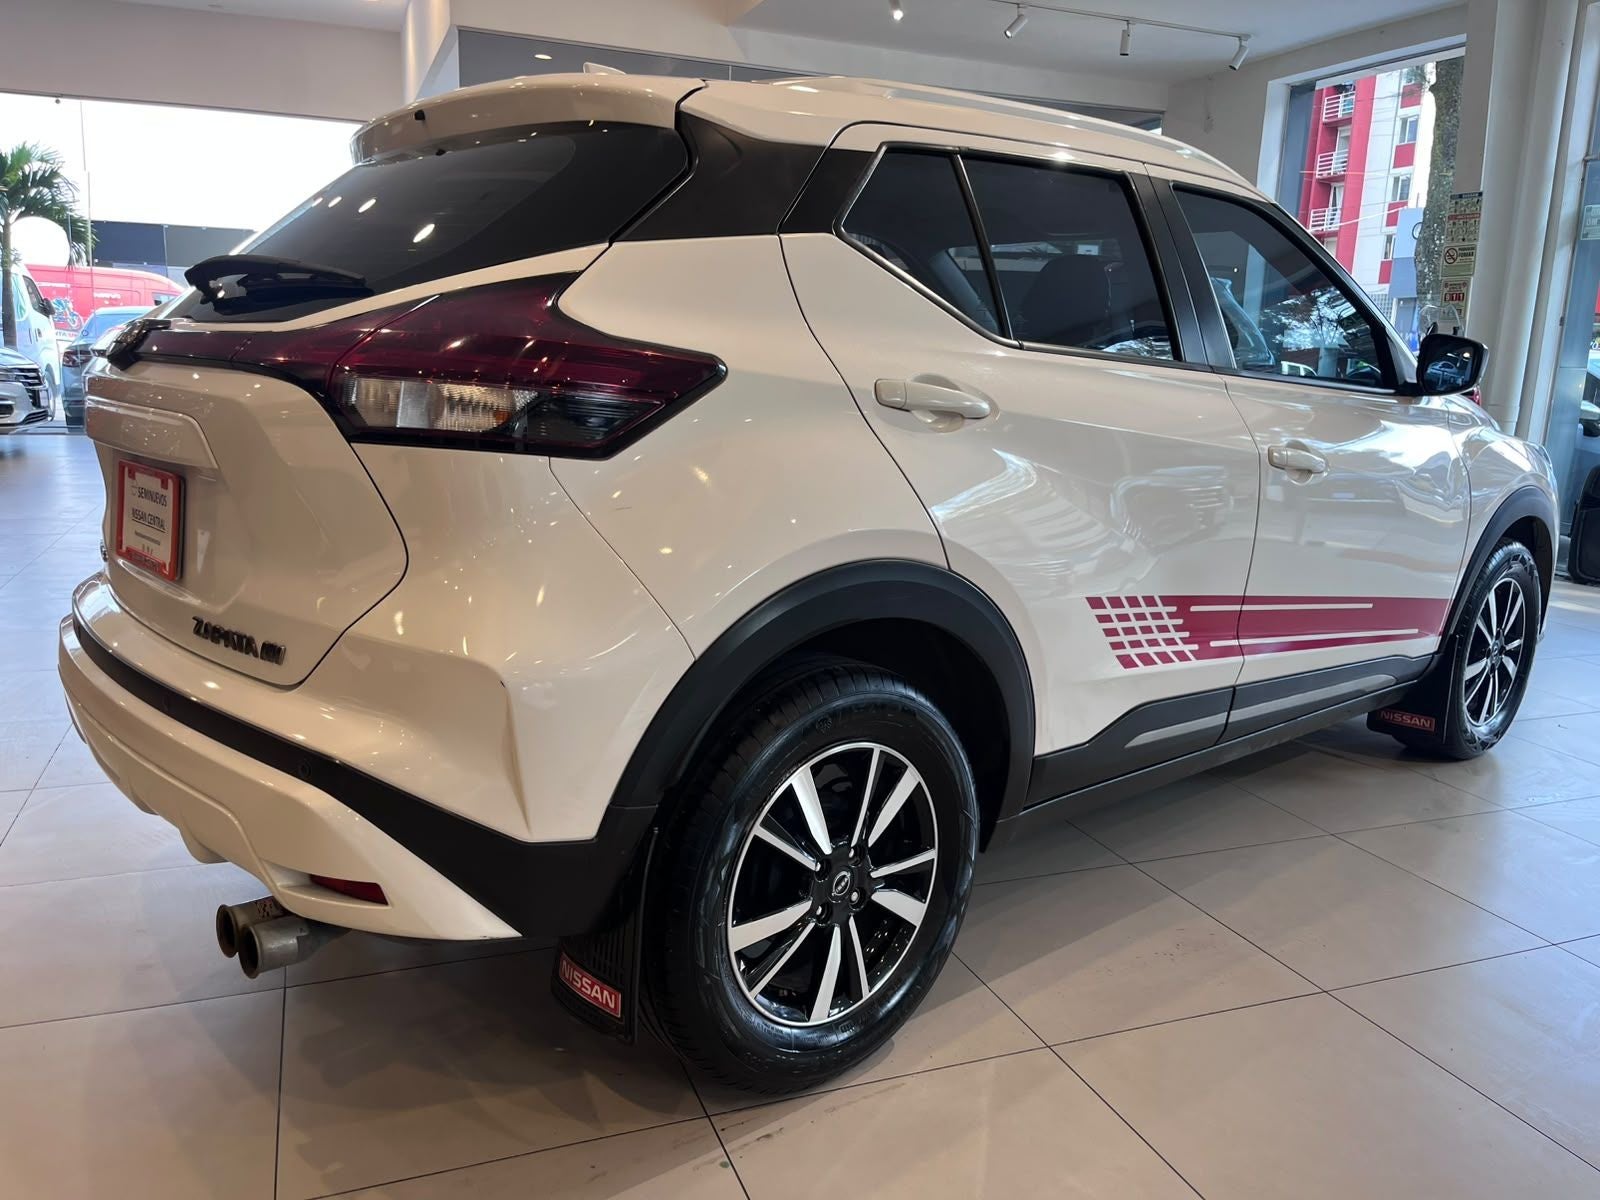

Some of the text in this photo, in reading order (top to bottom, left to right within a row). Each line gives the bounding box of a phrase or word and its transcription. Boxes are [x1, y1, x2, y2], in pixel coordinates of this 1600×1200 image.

[1445, 293, 1464, 301] 911
[137, 487, 168, 507] SEMINUEVOS
[148, 513, 166, 530] CENTRAL
[1380, 710, 1431, 727] NISSAN
[561, 960, 615, 1009] NISSAN
